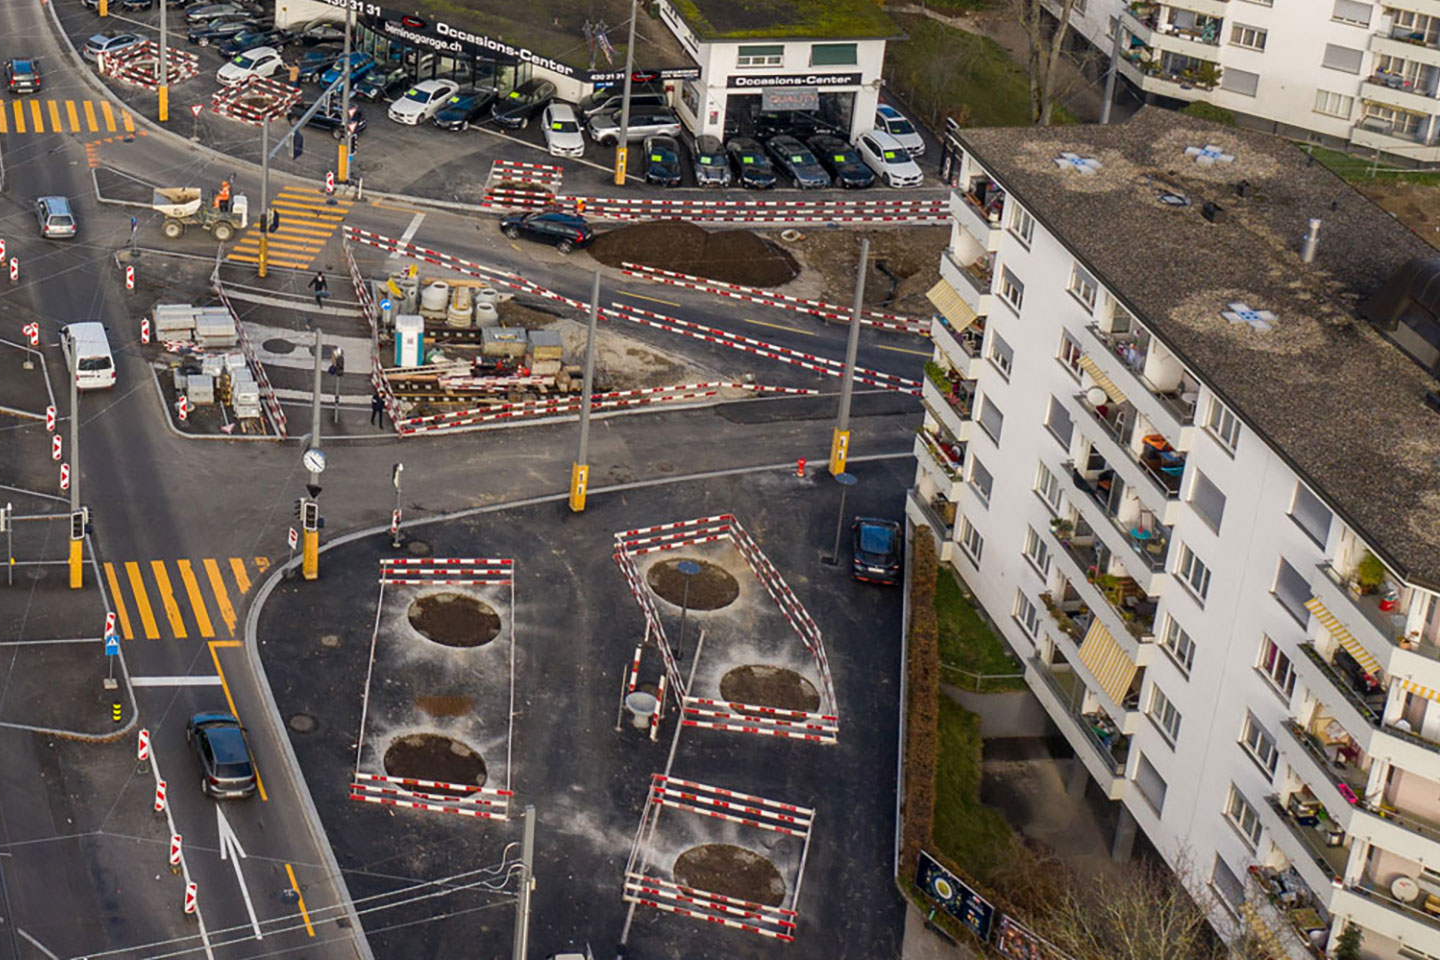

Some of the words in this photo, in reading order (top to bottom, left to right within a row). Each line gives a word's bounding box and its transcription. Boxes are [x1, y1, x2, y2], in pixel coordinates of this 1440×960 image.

[350, 1, 364, 13] 31
[366, 4, 381, 17] 31
[436, 22, 574, 75] Occasions-Center
[735, 76, 852, 86] Occasions-Center
[769, 93, 819, 105] QUALITY
